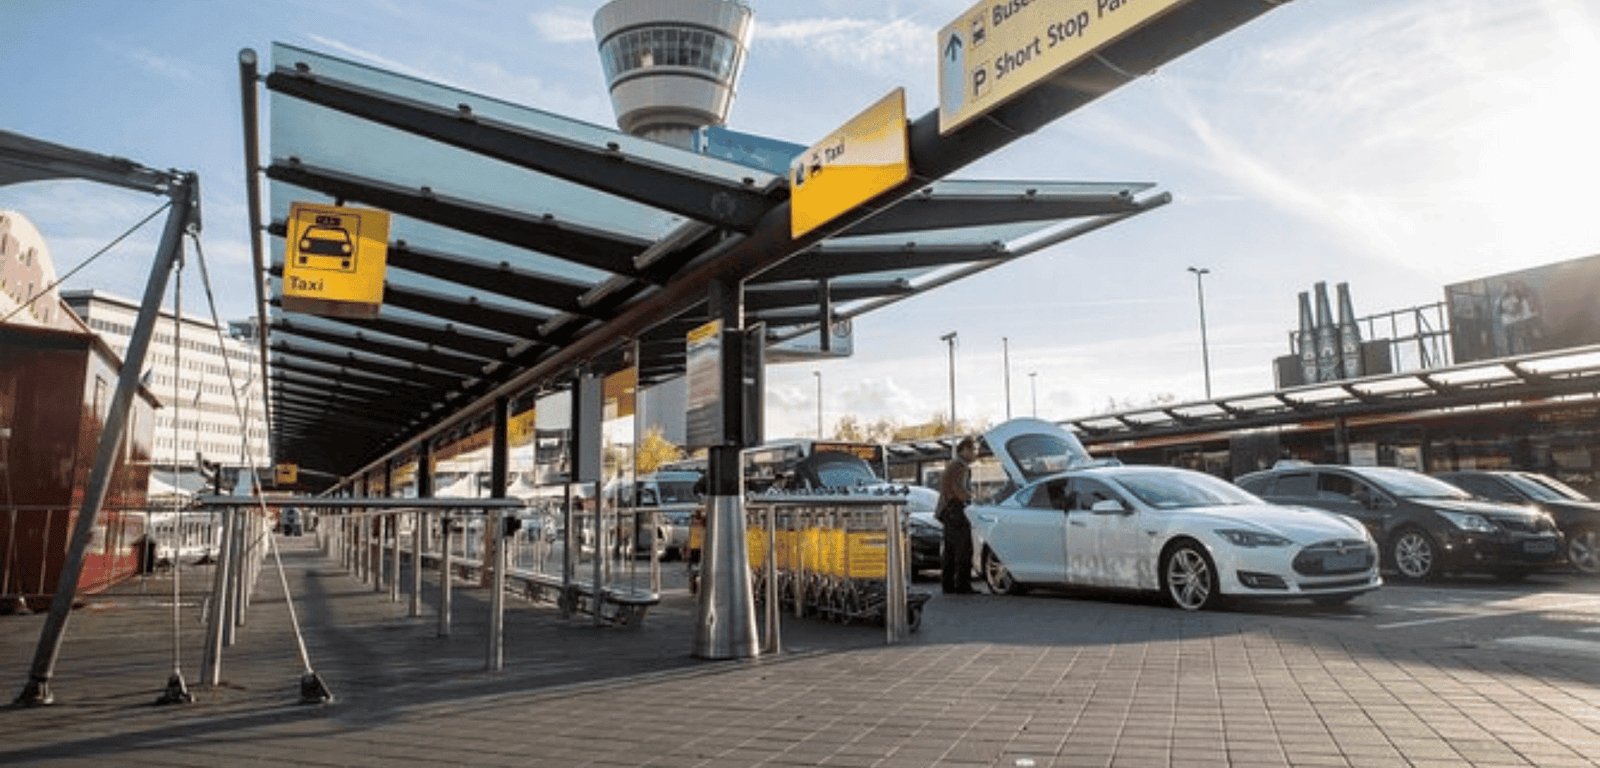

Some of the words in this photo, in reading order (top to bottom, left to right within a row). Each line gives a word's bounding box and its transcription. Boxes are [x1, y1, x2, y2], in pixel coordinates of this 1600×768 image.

[973, 68, 986, 97] P
[995, 36, 1041, 80] Short
[1047, 10, 1089, 48] Stop
[825, 136, 845, 163] Taxi
[289, 274, 324, 292] Taxi
